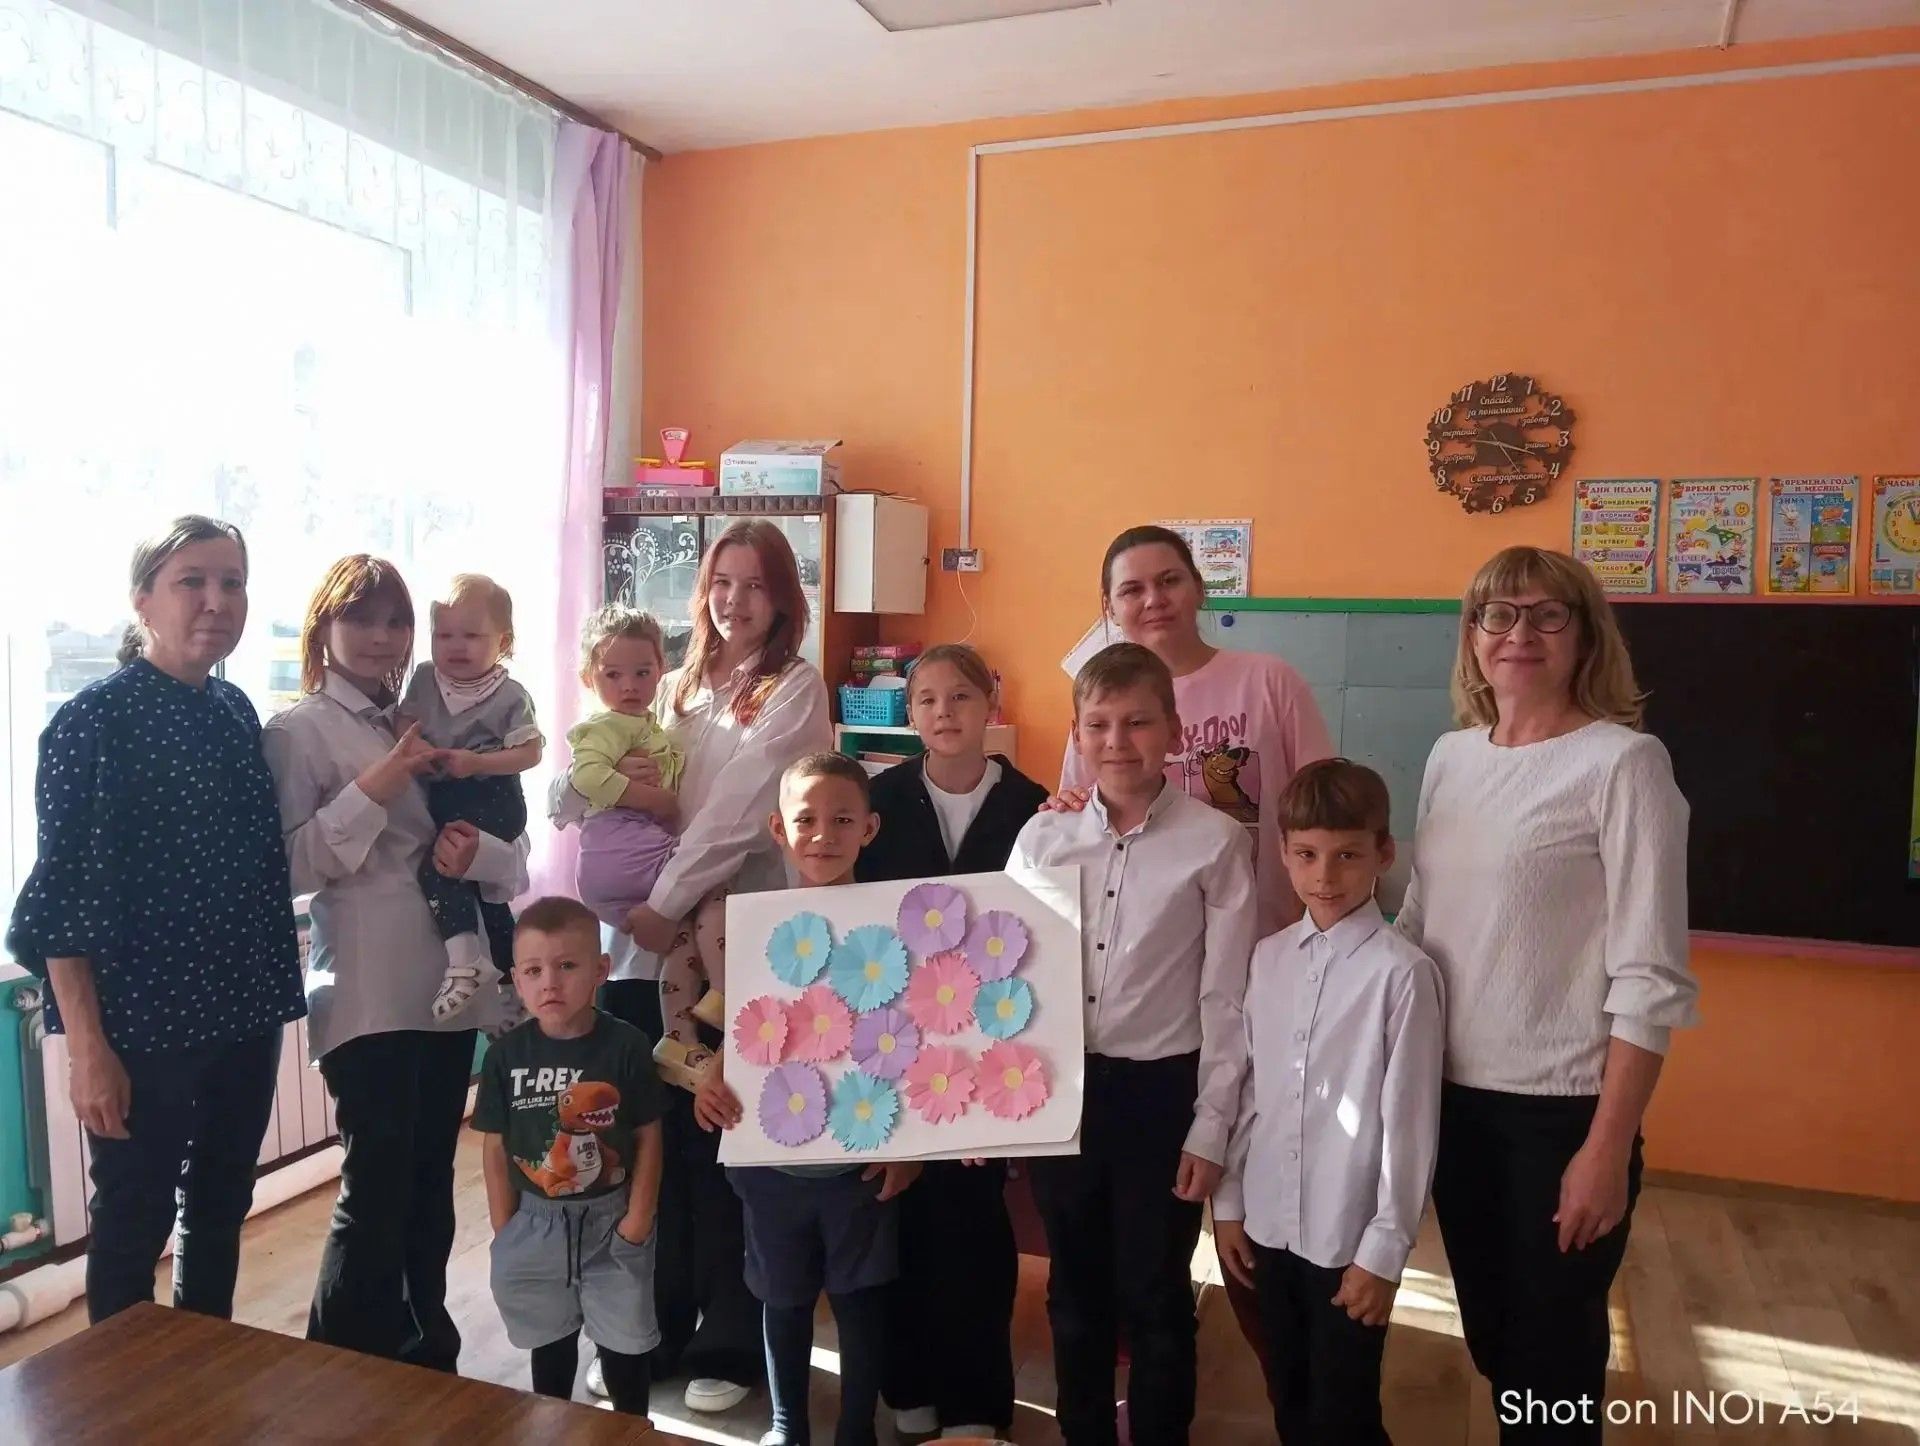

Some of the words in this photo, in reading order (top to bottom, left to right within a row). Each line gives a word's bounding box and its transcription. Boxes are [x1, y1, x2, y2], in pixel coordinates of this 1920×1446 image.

[1490, 375, 1507, 392] 12
[1526, 379, 1533, 394] 1
[1460, 384, 1473, 402] 11
[1480, 395, 1513, 405] Спасибо
[1434, 408, 1451, 424] 10
[1479, 406, 1526, 416] понимание
[1550, 400, 1562, 416] 2
[1558, 431, 1570, 446] 3
[1430, 441, 1440, 456] 9
[1436, 470, 1446, 486] 8
[1549, 463, 1559, 479] 4
[1463, 487, 1472, 503] 7
[1524, 488, 1536, 503] 5
[1492, 497, 1504, 513] 6
[510, 1067, 584, 1097] T-REX
[528, 1096, 543, 1104] LIKE
